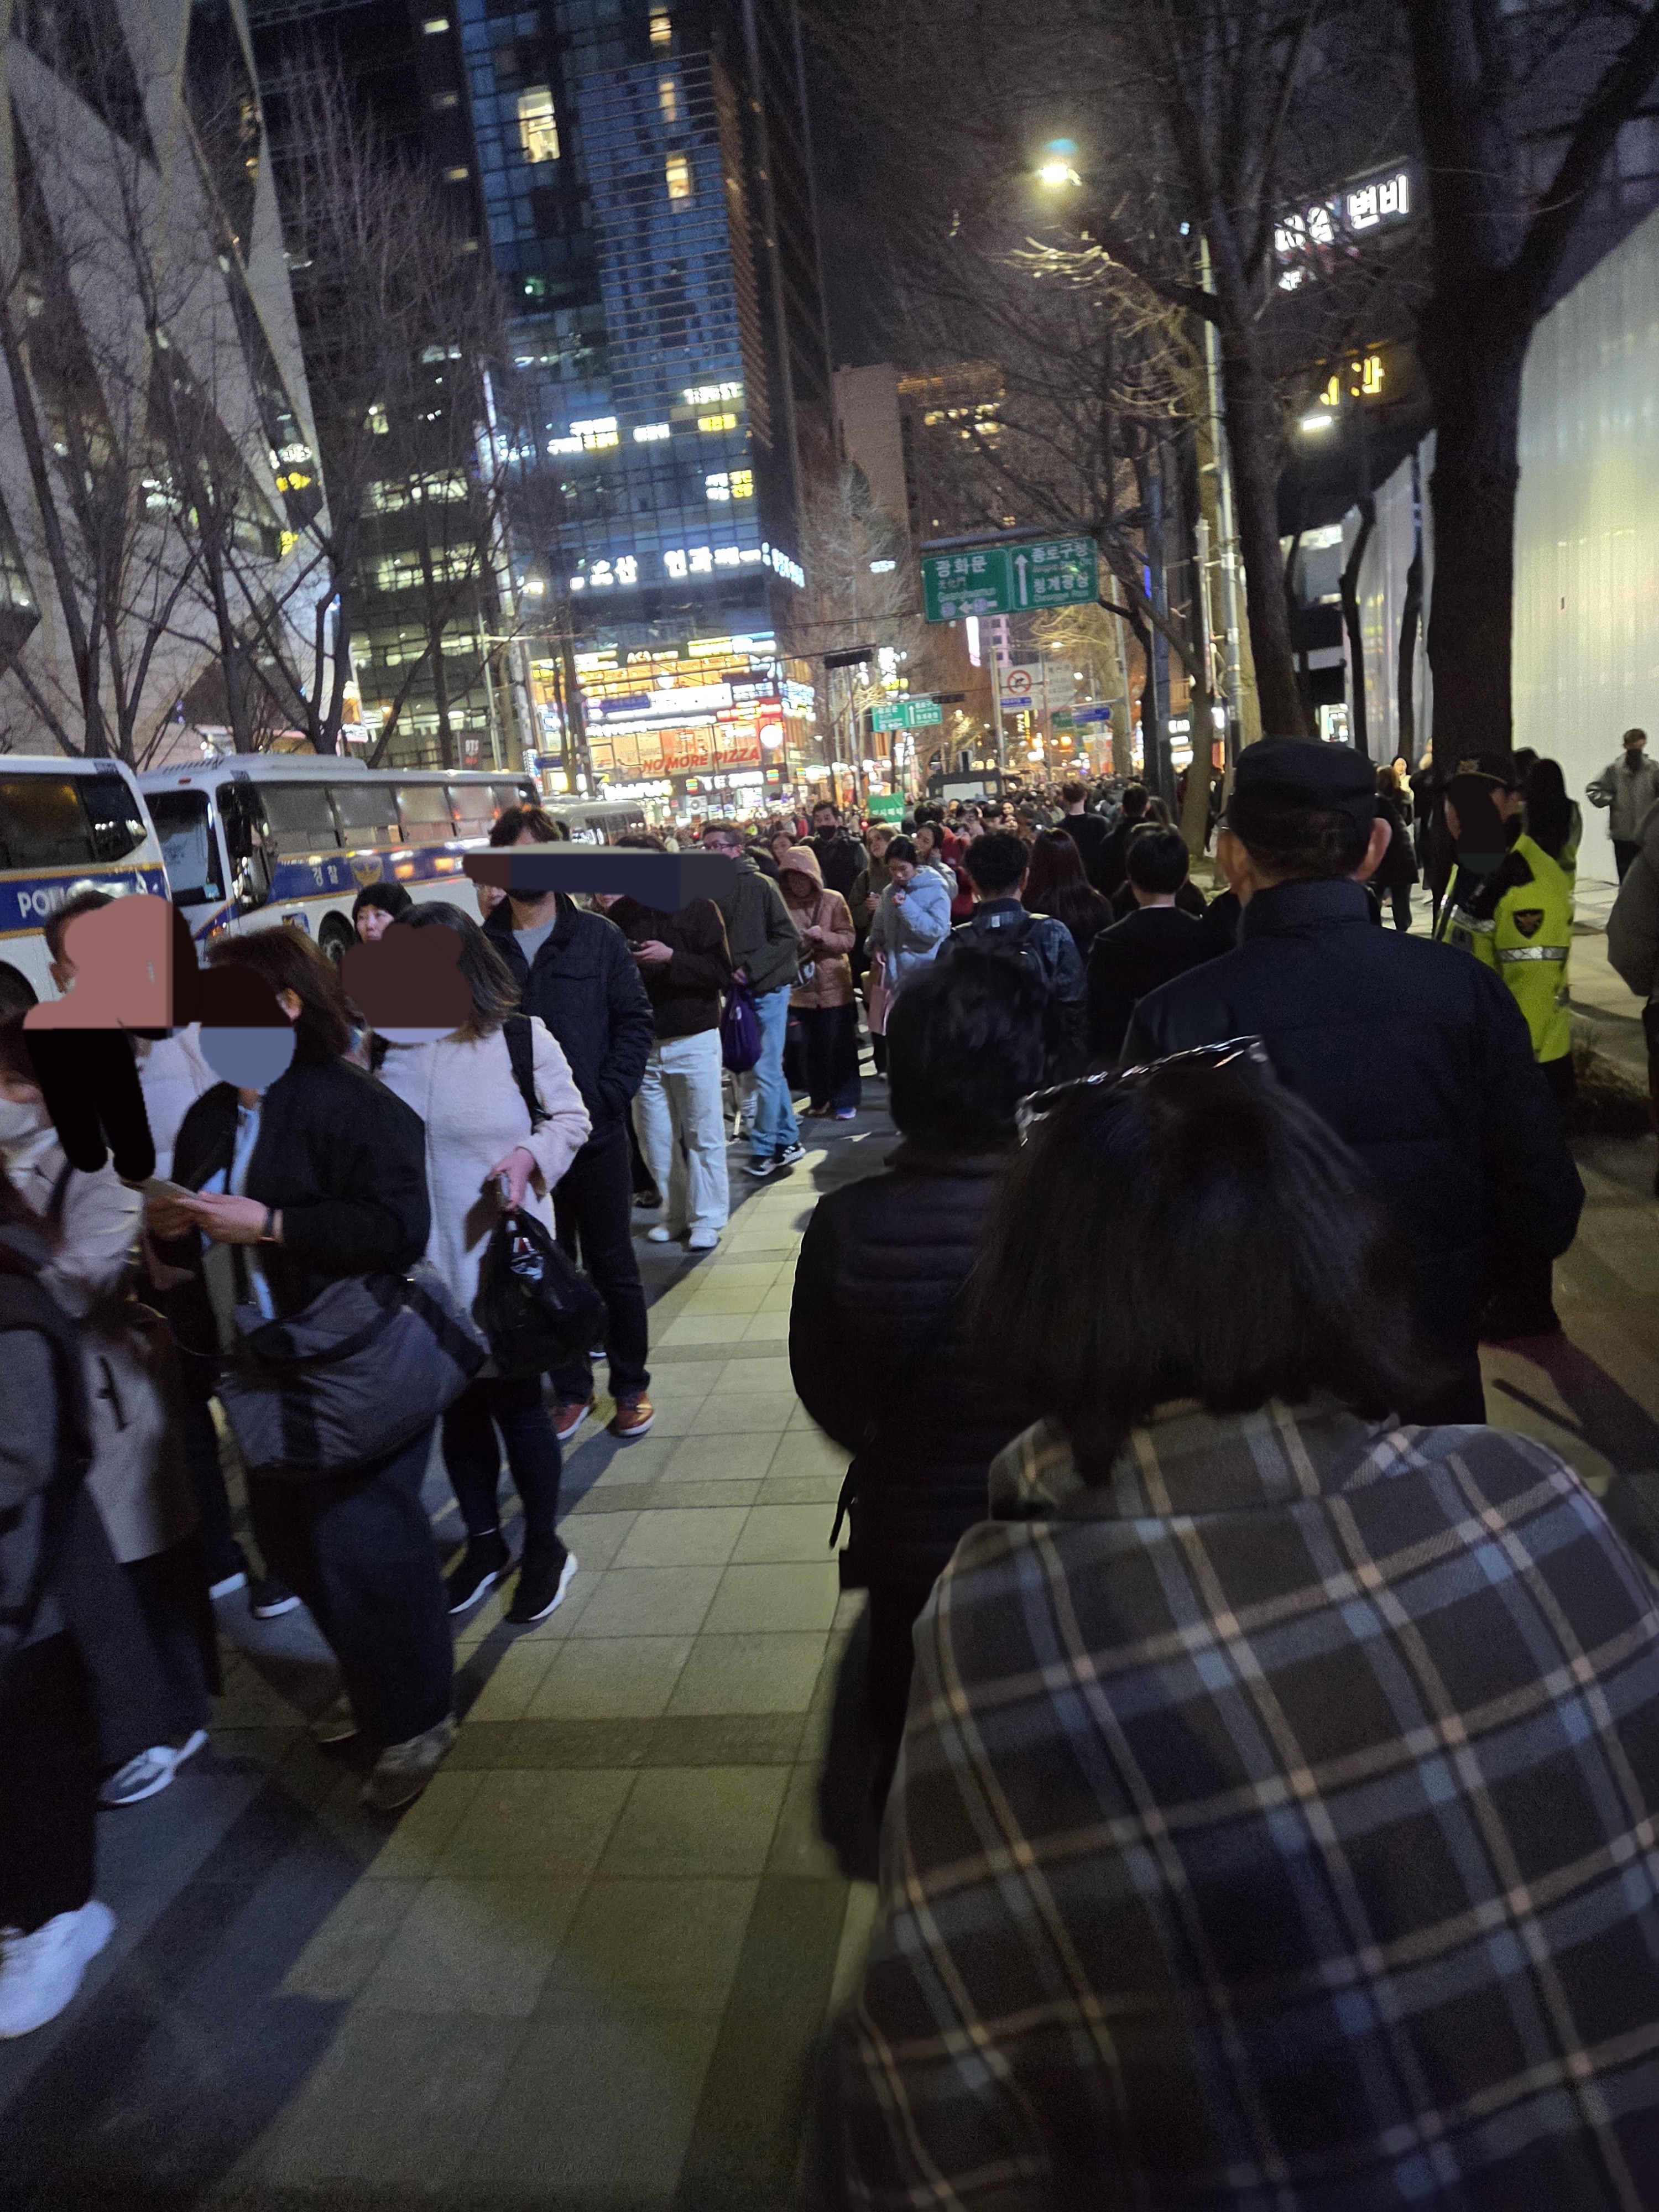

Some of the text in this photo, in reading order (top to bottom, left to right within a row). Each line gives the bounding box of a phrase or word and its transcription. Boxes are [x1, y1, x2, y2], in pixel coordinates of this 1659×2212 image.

[1348, 174, 1408, 229] 변비
[936, 555, 988, 578] 광화문
[642, 748, 760, 773] NO MORE PIZZA
